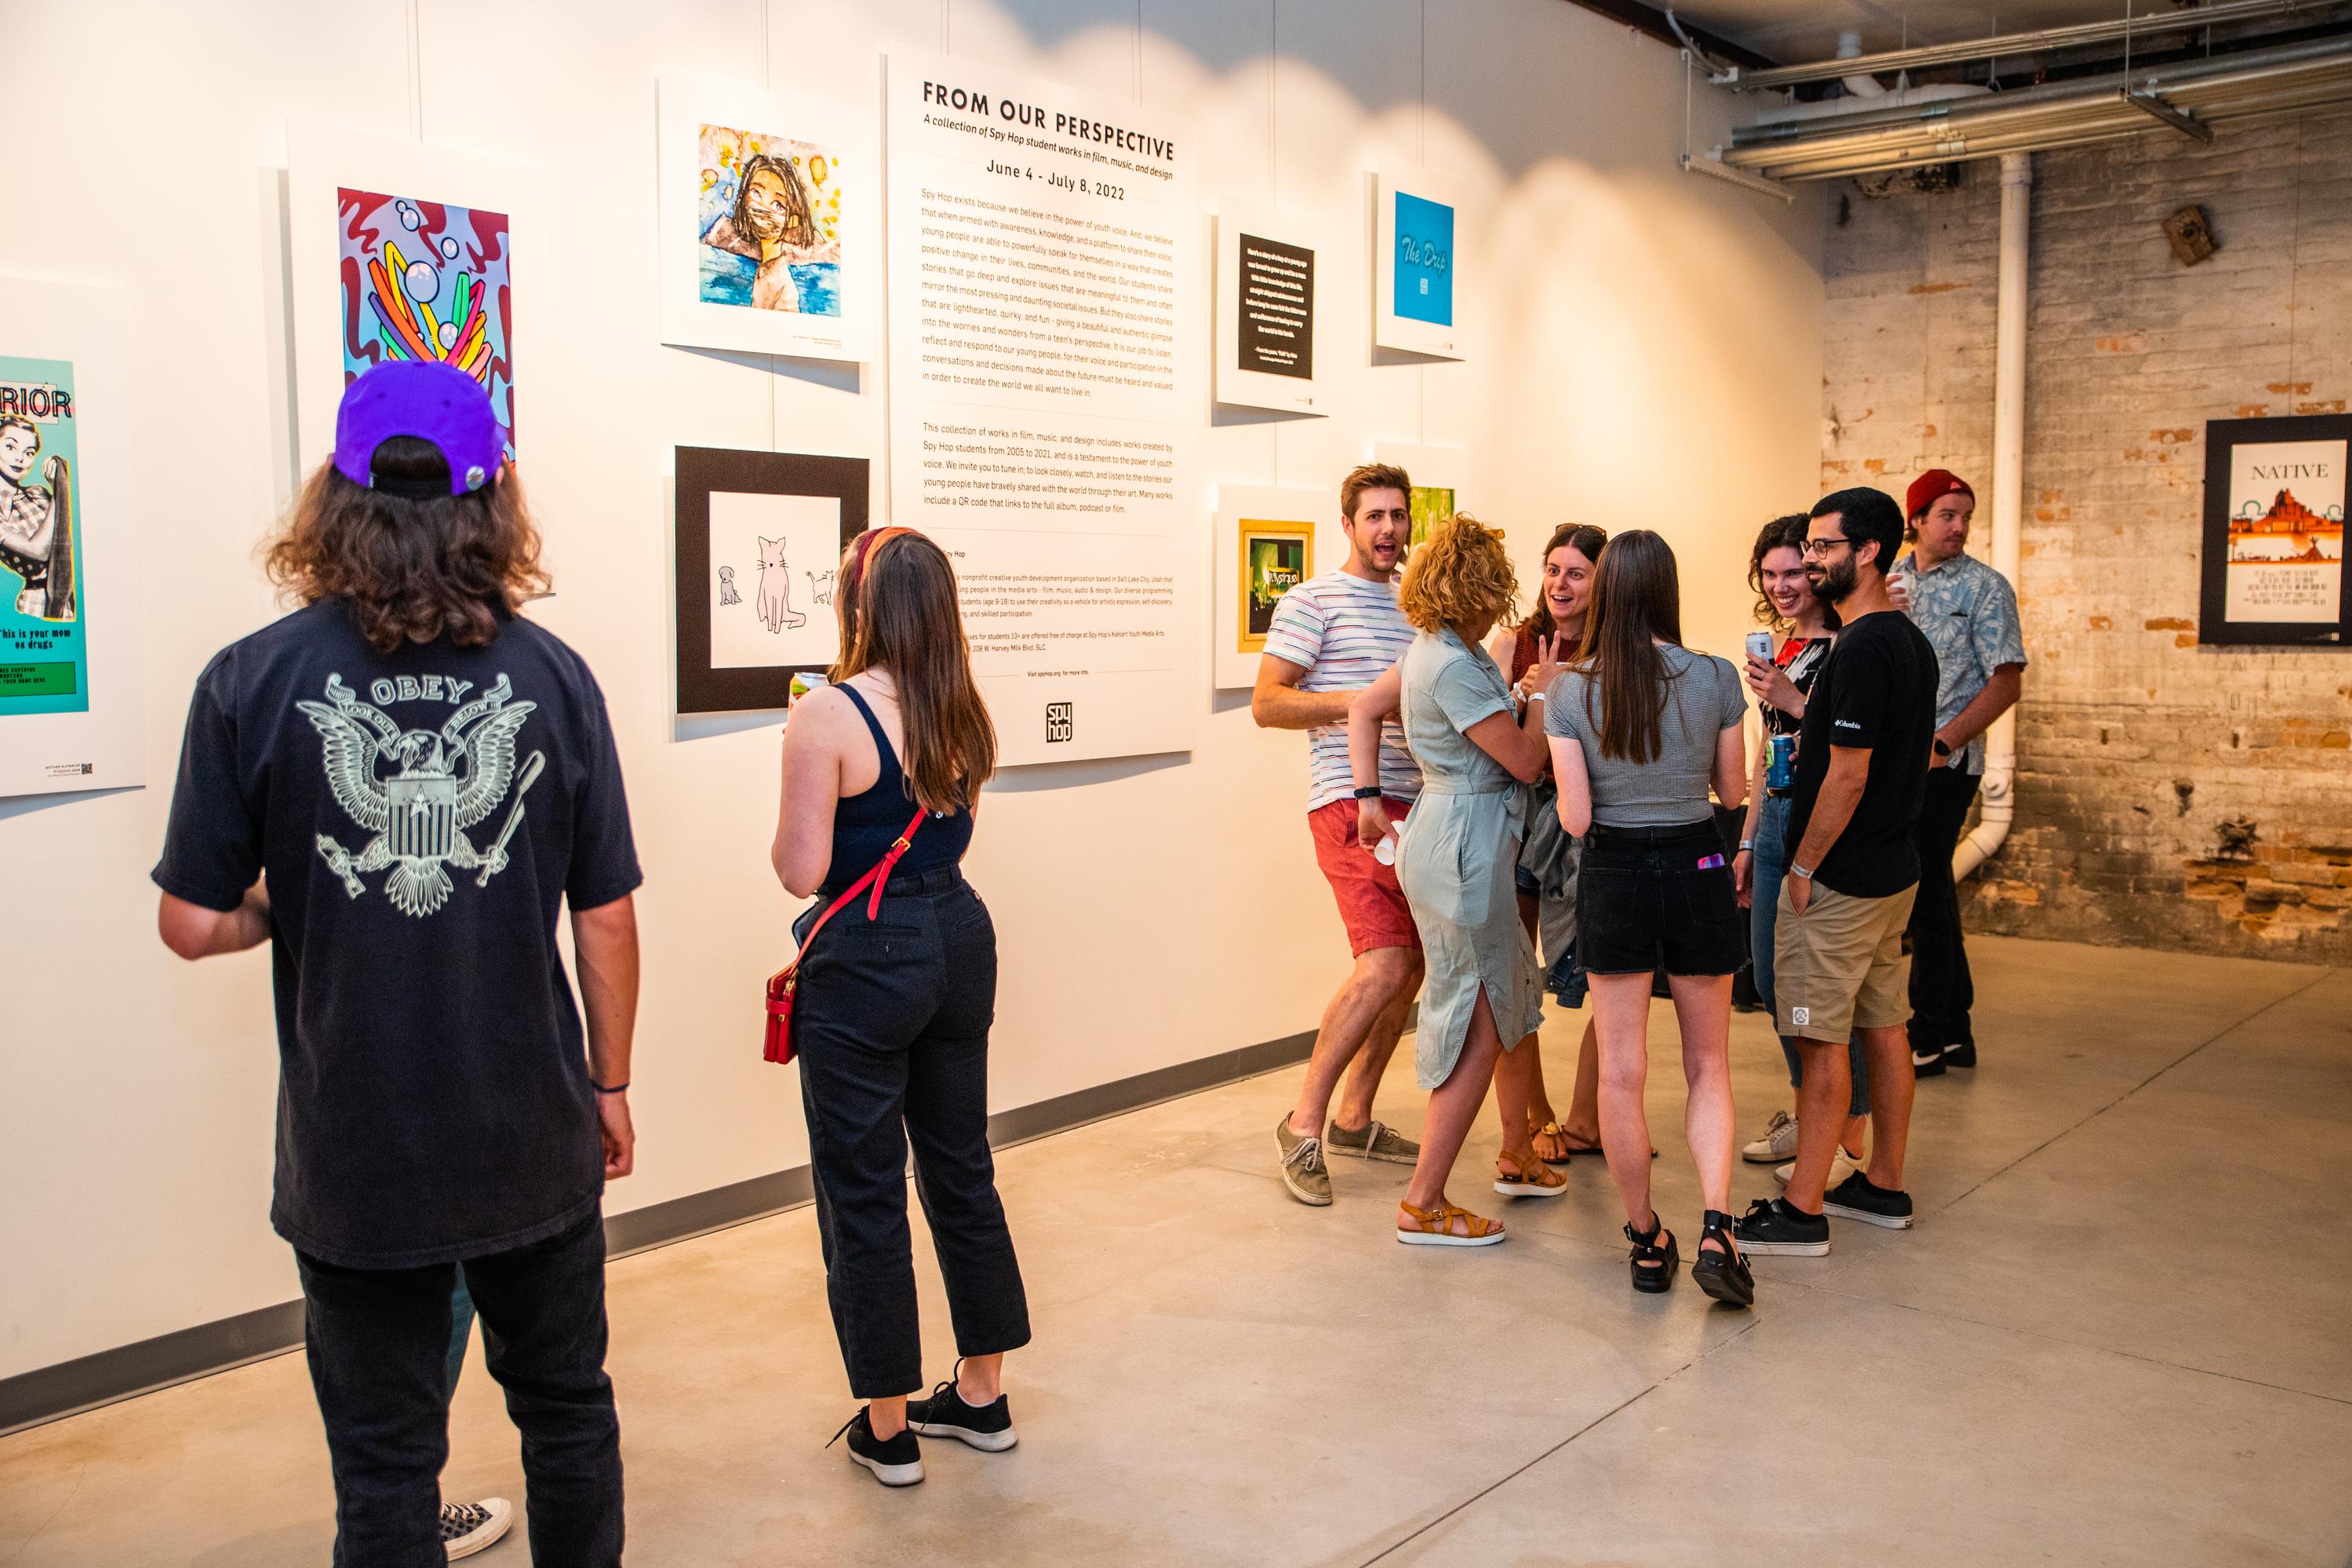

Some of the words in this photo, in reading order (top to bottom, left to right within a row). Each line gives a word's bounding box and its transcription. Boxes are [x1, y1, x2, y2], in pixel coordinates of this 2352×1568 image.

[923, 81, 988, 115] FROM
[999, 100, 1045, 129] OUR
[1056, 112, 1173, 161] PERSPECTIVE
[923, 114, 930, 123] A
[932, 117, 976, 133] collection
[979, 126, 988, 138] of
[989, 127, 1005, 141] Spy
[1007, 131, 1024, 146] Hop
[1026, 137, 1056, 151] student
[1058, 145, 1081, 157] works
[1083, 149, 1090, 159] in
[1092, 151, 1109, 165] film,
[1110, 158, 1133, 171] music,
[1135, 164, 1149, 173] and
[1150, 166, 1172, 180] design
[987, 159, 1019, 177] June
[1025, 167, 1032, 180] 4
[1048, 172, 1075, 191] July
[1080, 179, 1090, 195] 8,
[1096, 182, 1123, 200] 2022
[921, 227, 943, 238] young
[946, 231, 970, 242] people
[985, 236, 1001, 246] able
[1003, 239, 1010, 248] to
[1011, 242, 1047, 256] powerfully
[1048, 248, 1067, 257] speak
[1069, 250, 1077, 260] for
[1080, 253, 1113, 267] themselves
[1115, 259, 1120, 267] in
[1127, 264, 1138, 273] way
[1139, 264, 1150, 274] that
[1152, 268, 1172, 278] creates
[1402, 236, 1421, 264] The
[1424, 242, 1447, 274] Drip
[923, 355, 974, 367] conversations
[976, 359, 988, 369] and
[991, 360, 1023, 373] decisions
[1025, 366, 1043, 375] made
[1045, 367, 1064, 377] about
[1065, 369, 1076, 378] the
[1077, 370, 1097, 381] future
[1115, 376, 1122, 384] be
[1123, 377, 1141, 386] heard
[1153, 381, 1172, 391] valued
[923, 422, 938, 432] This
[941, 424, 976, 435] collection
[979, 427, 985, 435] of
[988, 429, 1009, 438] works
[1020, 430, 1034, 440] film,
[1060, 435, 1072, 443] and
[1074, 435, 1094, 446] design
[1097, 437, 1121, 447] includes
[1123, 440, 1141, 449] works
[1142, 442, 1163, 451] created
[1166, 443, 1172, 453] by
[923, 440, 937, 452] Spy
[939, 442, 953, 452] Hop
[956, 444, 986, 453] students
[988, 445, 1004, 454] from
[1007, 446, 1024, 457] 2005
[1054, 451, 1065, 460] and
[1067, 451, 1072, 460] is
[1080, 453, 1111, 463] testament
[1112, 455, 1118, 464] to
[1120, 456, 1129, 464] the
[1156, 460, 1172, 468] youth
[2252, 464, 2328, 480] NATIVE
[923, 478, 945, 489] young
[947, 479, 971, 489] people
[973, 479, 989, 489] have
[991, 480, 1016, 493] bravely
[1018, 482, 1040, 492] shared
[1042, 484, 1055, 493] with
[1057, 485, 1067, 493] the
[1087, 486, 1112, 497] through
[1139, 489, 1153, 500] Many
[1156, 491, 1172, 500] works
[924, 495, 950, 504] include
[959, 496, 968, 506] QR
[971, 497, 987, 507] code
[989, 498, 1003, 507] that
[1005, 499, 1021, 508] links
[1023, 500, 1029, 508] to
[1031, 500, 1042, 509] the
[1043, 500, 1054, 510] full
[1056, 501, 1077, 511] album,
[1080, 503, 1103, 512] podcast
[1112, 504, 1126, 513] film.
[954, 550, 966, 558] Hop
[1269, 572, 1298, 584] Mystique
[999, 609, 1033, 618] participation.
[19, 629, 26, 638] is
[30, 629, 49, 639] your
[28, 640, 53, 649] drugs
[370, 674, 474, 706] OBEY
[345, 705, 373, 718] LOOK
[374, 712, 395, 733] OUT
[451, 701, 488, 728] BELOW
[1047, 704, 1071, 724] spy
[1839, 719, 1861, 729] Columbia
[1047, 721, 1072, 742] hop
